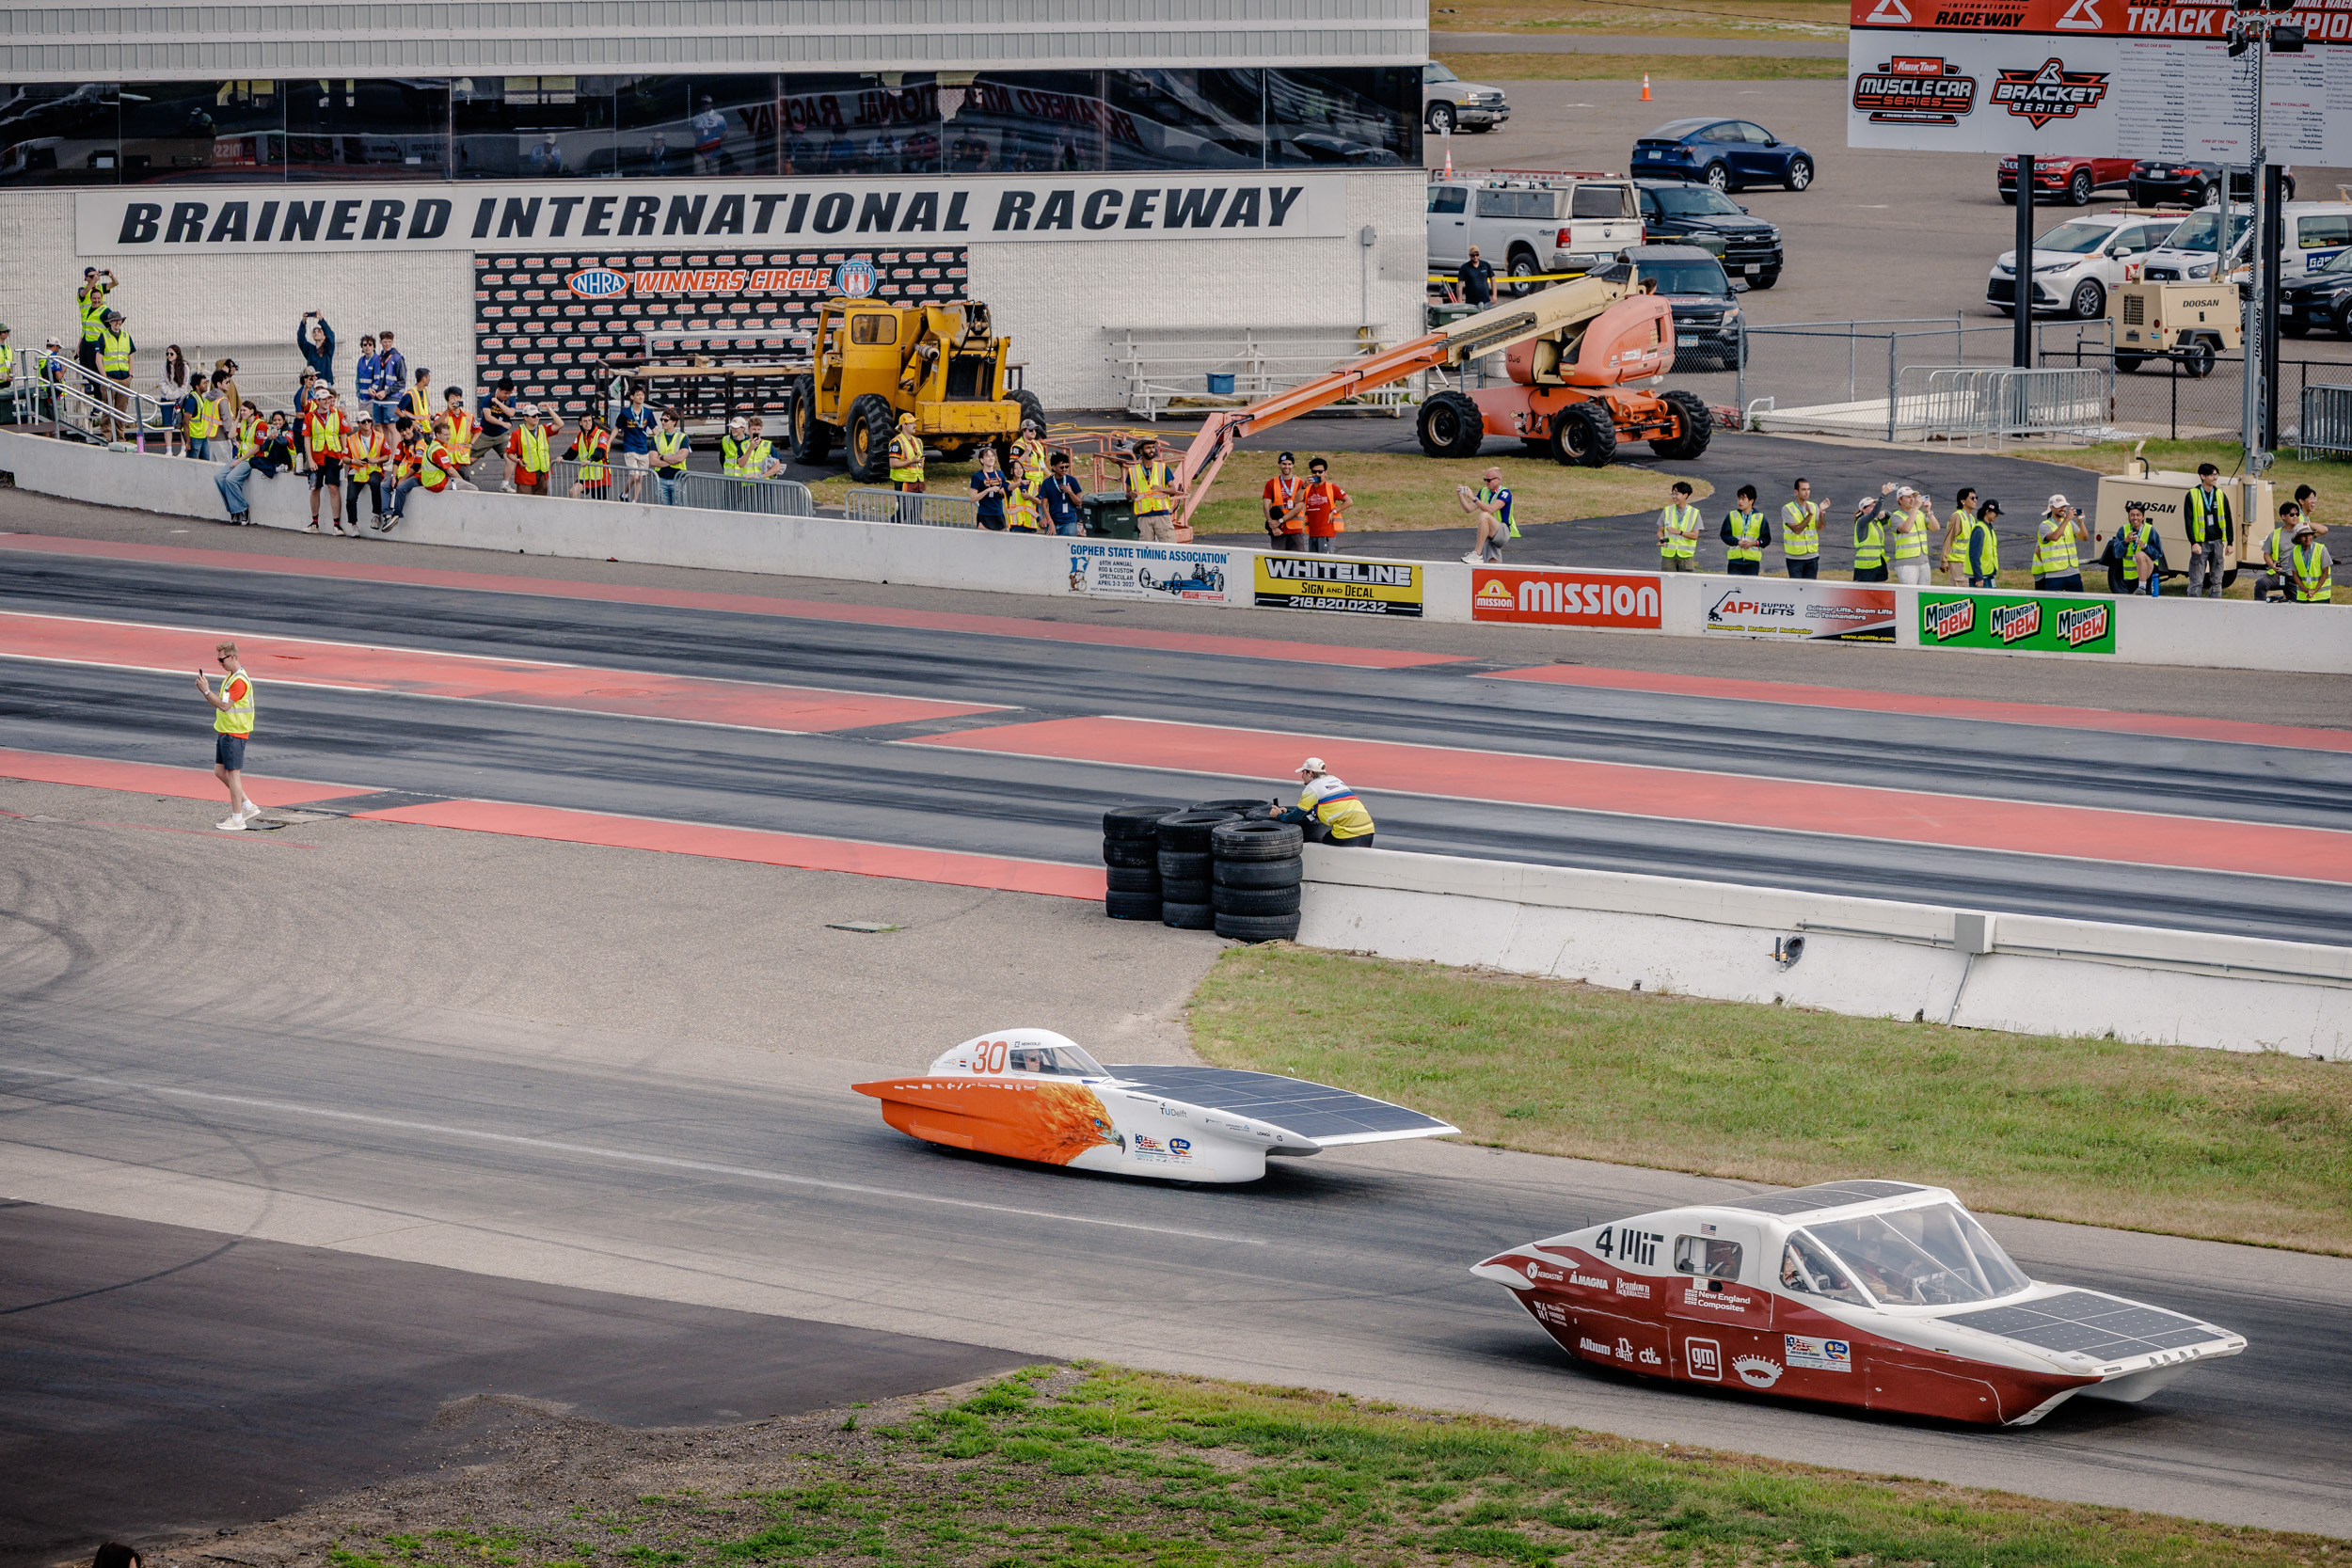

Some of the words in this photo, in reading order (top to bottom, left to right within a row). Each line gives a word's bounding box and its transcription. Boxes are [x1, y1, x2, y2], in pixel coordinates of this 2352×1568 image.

[1935, 11, 2026, 27] RACEWAY
[2127, 8, 2212, 34] TRACK
[1859, 78, 1933, 95] MUSCLE
[1935, 80, 1972, 97] CAR
[1996, 86, 2102, 103] BRACKET
[1883, 96, 1942, 107] SERIES
[2011, 103, 2075, 114] SERIES
[118, 199, 453, 244] BRAINERD
[470, 191, 969, 239] INTERNATIONAL
[993, 186, 1304, 232] RACEWAY
[578, 273, 621, 293] NHRA
[635, 270, 746, 293] WINNERS
[750, 268, 833, 291] CIRCLE
[2183, 299, 2219, 308] DOOSAN
[1071, 545, 1105, 556] GOPHER
[1108, 547, 1134, 558] STATE
[1136, 548, 1167, 560] TIMING
[1168, 550, 1227, 563] ASSOCIATION
[1264, 557, 1412, 586] WHITELINE
[1301, 582, 1325, 595] SIGN
[1344, 584, 1375, 598] DECAL
[1288, 596, 1388, 613] 218.820.0232
[1821, 612, 1867, 621] Telehandlers
[1708, 624, 1744, 632] Minneapolis
[973, 1040, 1008, 1074] 30
[1596, 1226, 1613, 1258] 4
[1537, 1271, 1563, 1281] AEROASTRO
[1579, 1275, 1609, 1290] MAGNA
[1616, 1277, 1650, 1291] Beantown
[1698, 1300, 1745, 1312] Composites
[1699, 1291, 1717, 1299] New
[1718, 1293, 1751, 1305] England
[1692, 1347, 1715, 1369] gm
